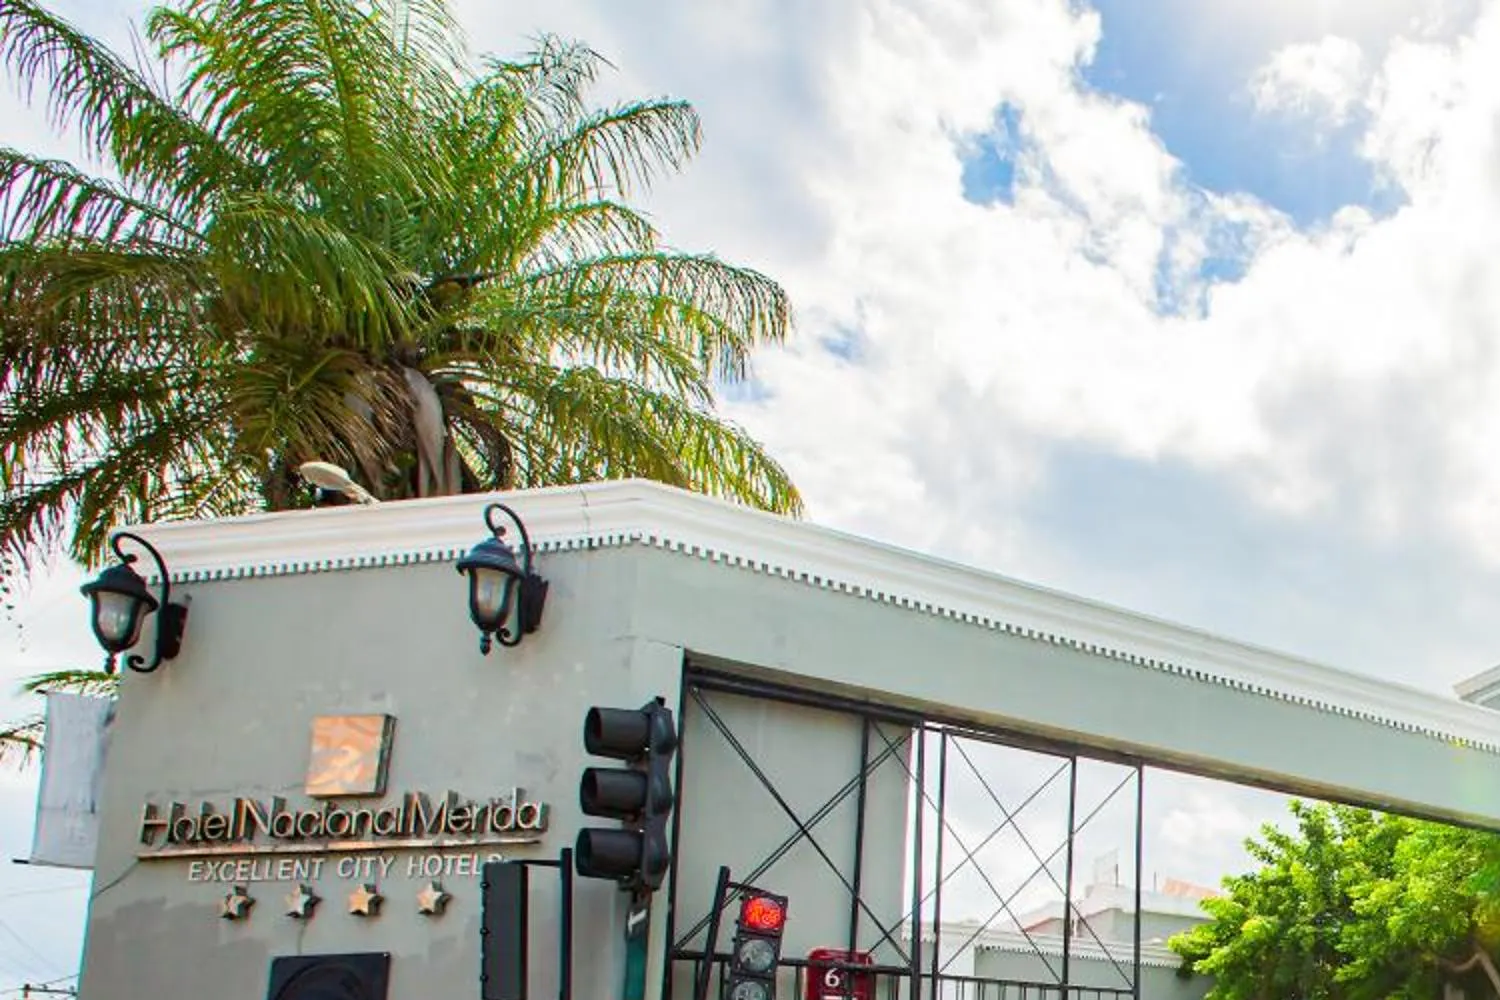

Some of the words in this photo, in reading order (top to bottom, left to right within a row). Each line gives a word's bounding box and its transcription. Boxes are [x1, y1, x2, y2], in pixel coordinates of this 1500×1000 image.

[140, 799, 236, 846] Hotel
[238, 795, 404, 841] Nacional
[188, 857, 326, 882] EXCELLENT
[336, 855, 395, 879] CITY
